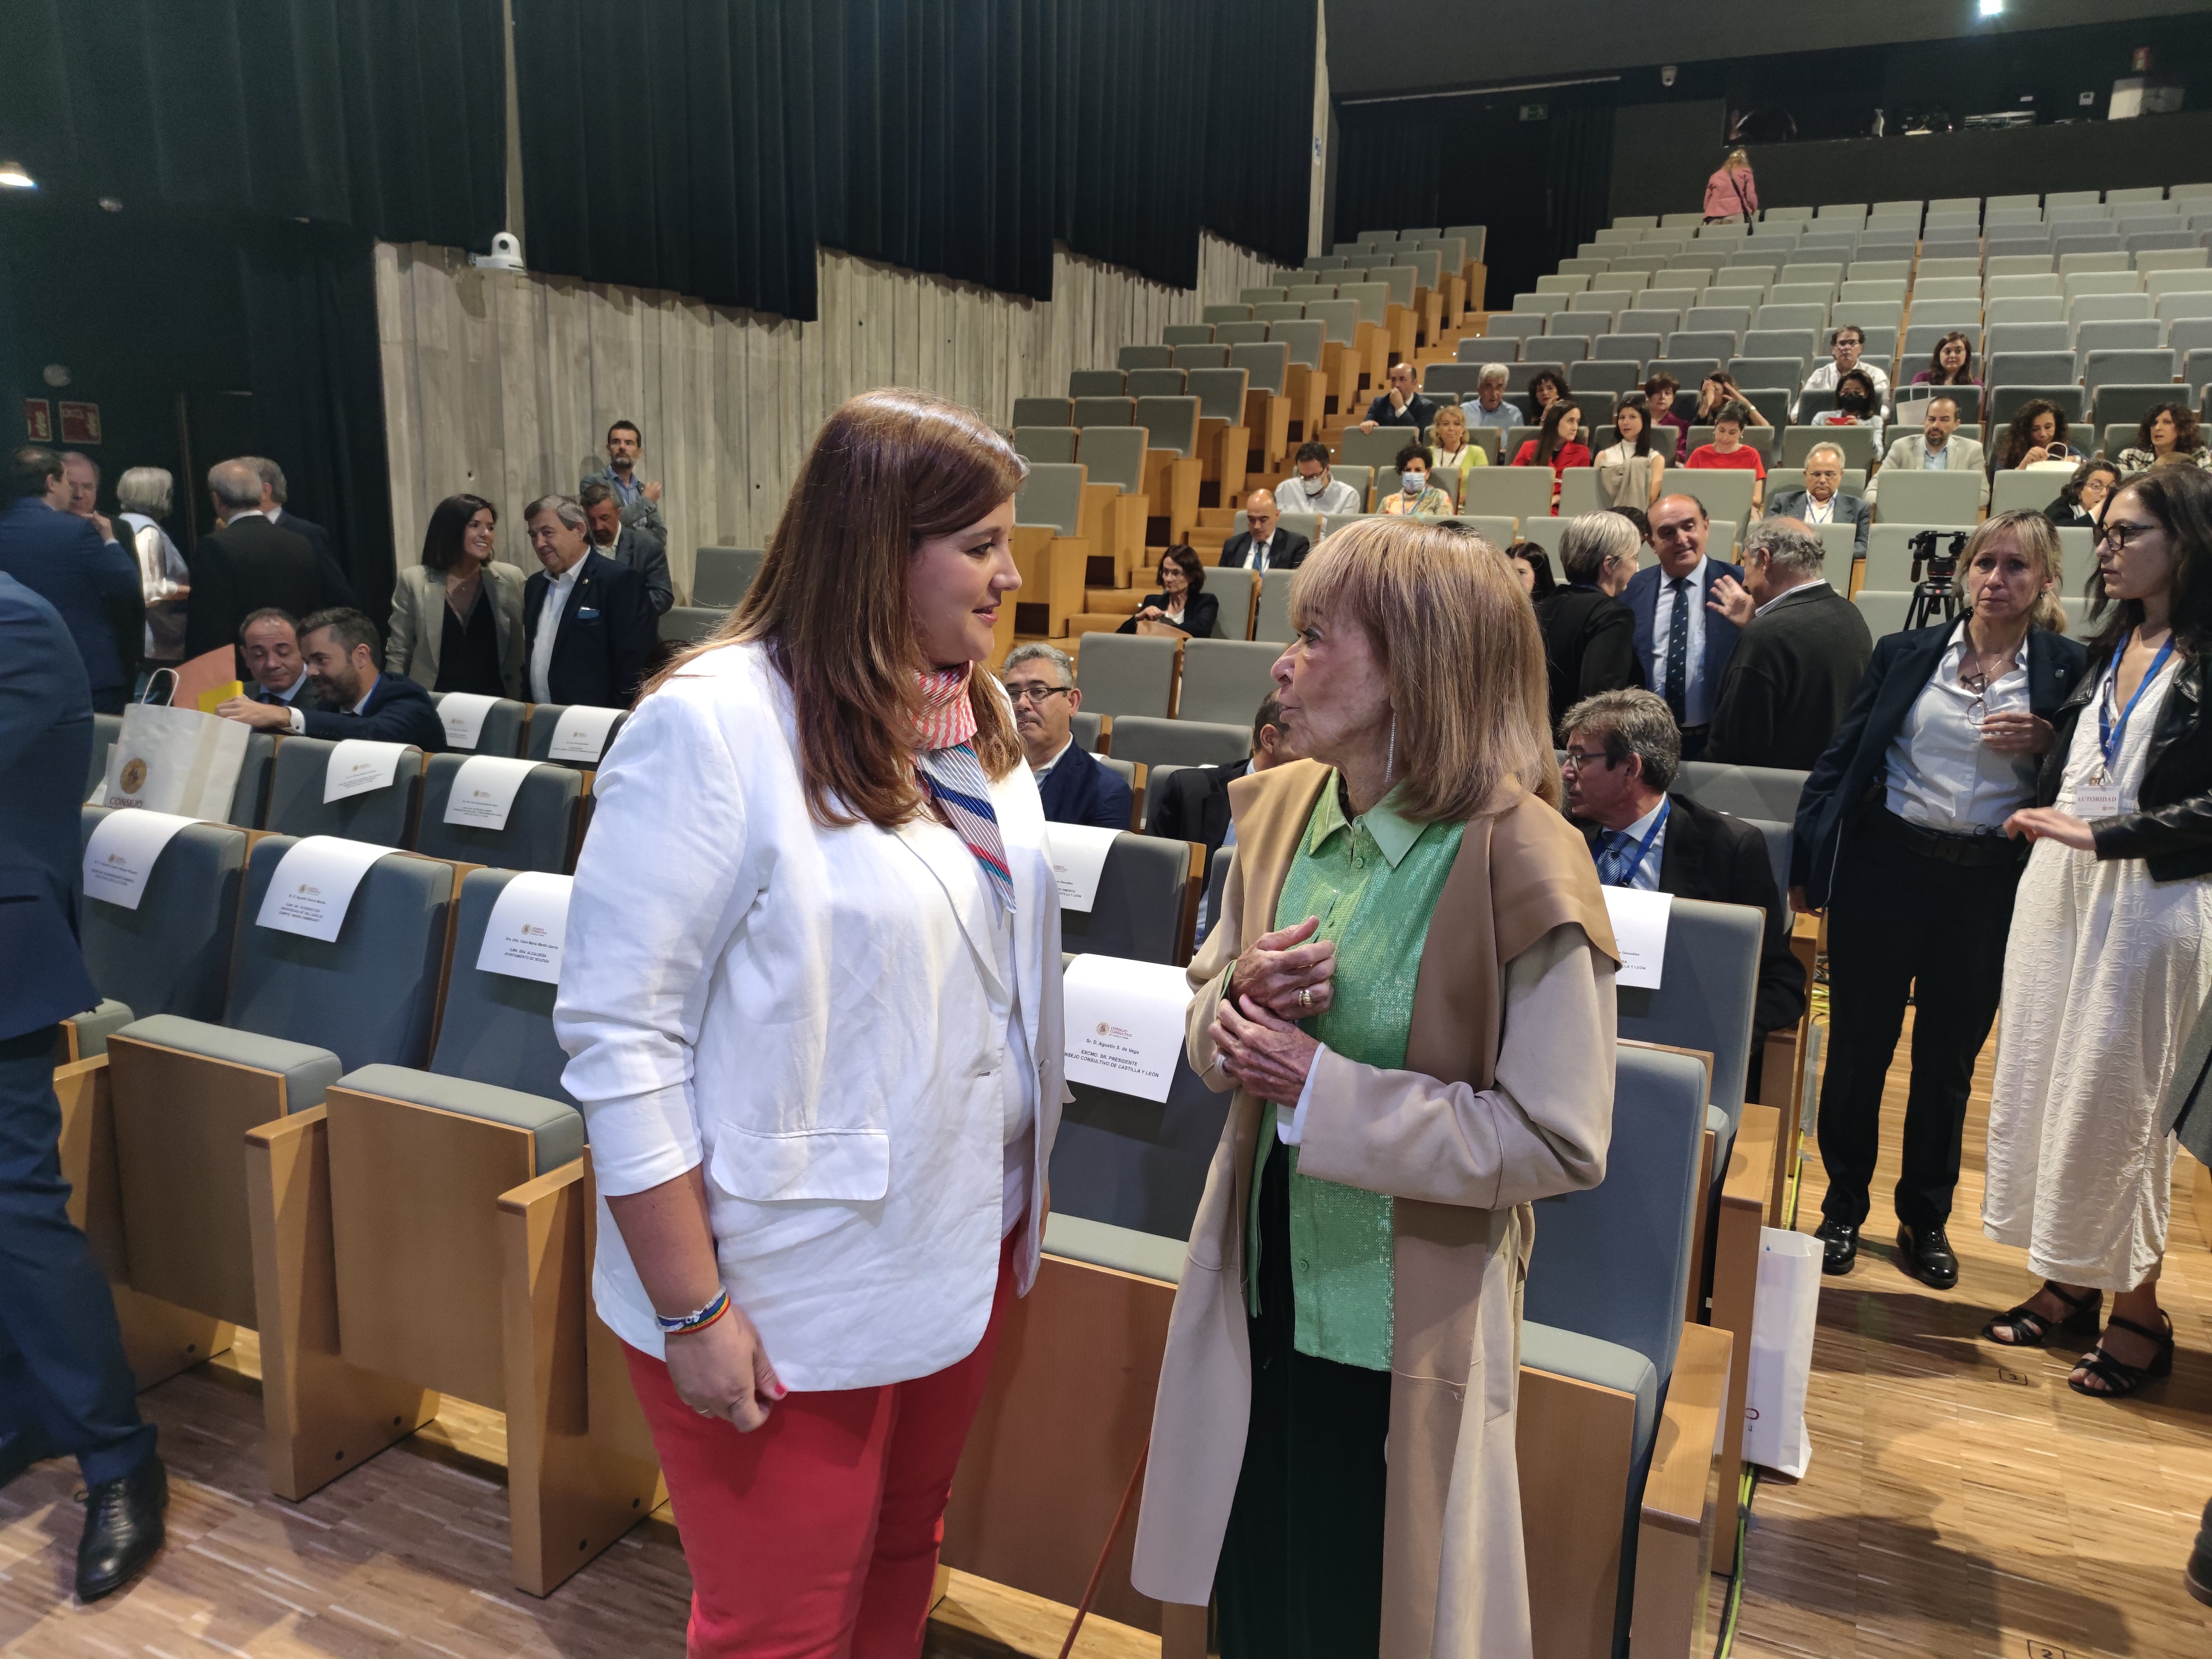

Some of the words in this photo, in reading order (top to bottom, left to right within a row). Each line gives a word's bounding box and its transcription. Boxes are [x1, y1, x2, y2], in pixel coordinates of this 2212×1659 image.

[109, 797, 143, 808] CONSEJO
[1080, 1056, 1110, 1066] CONSULTIVO
[1118, 1064, 1141, 1074] CASTILLA
[1109, 1056, 1138, 1067] PRESIDENTE
